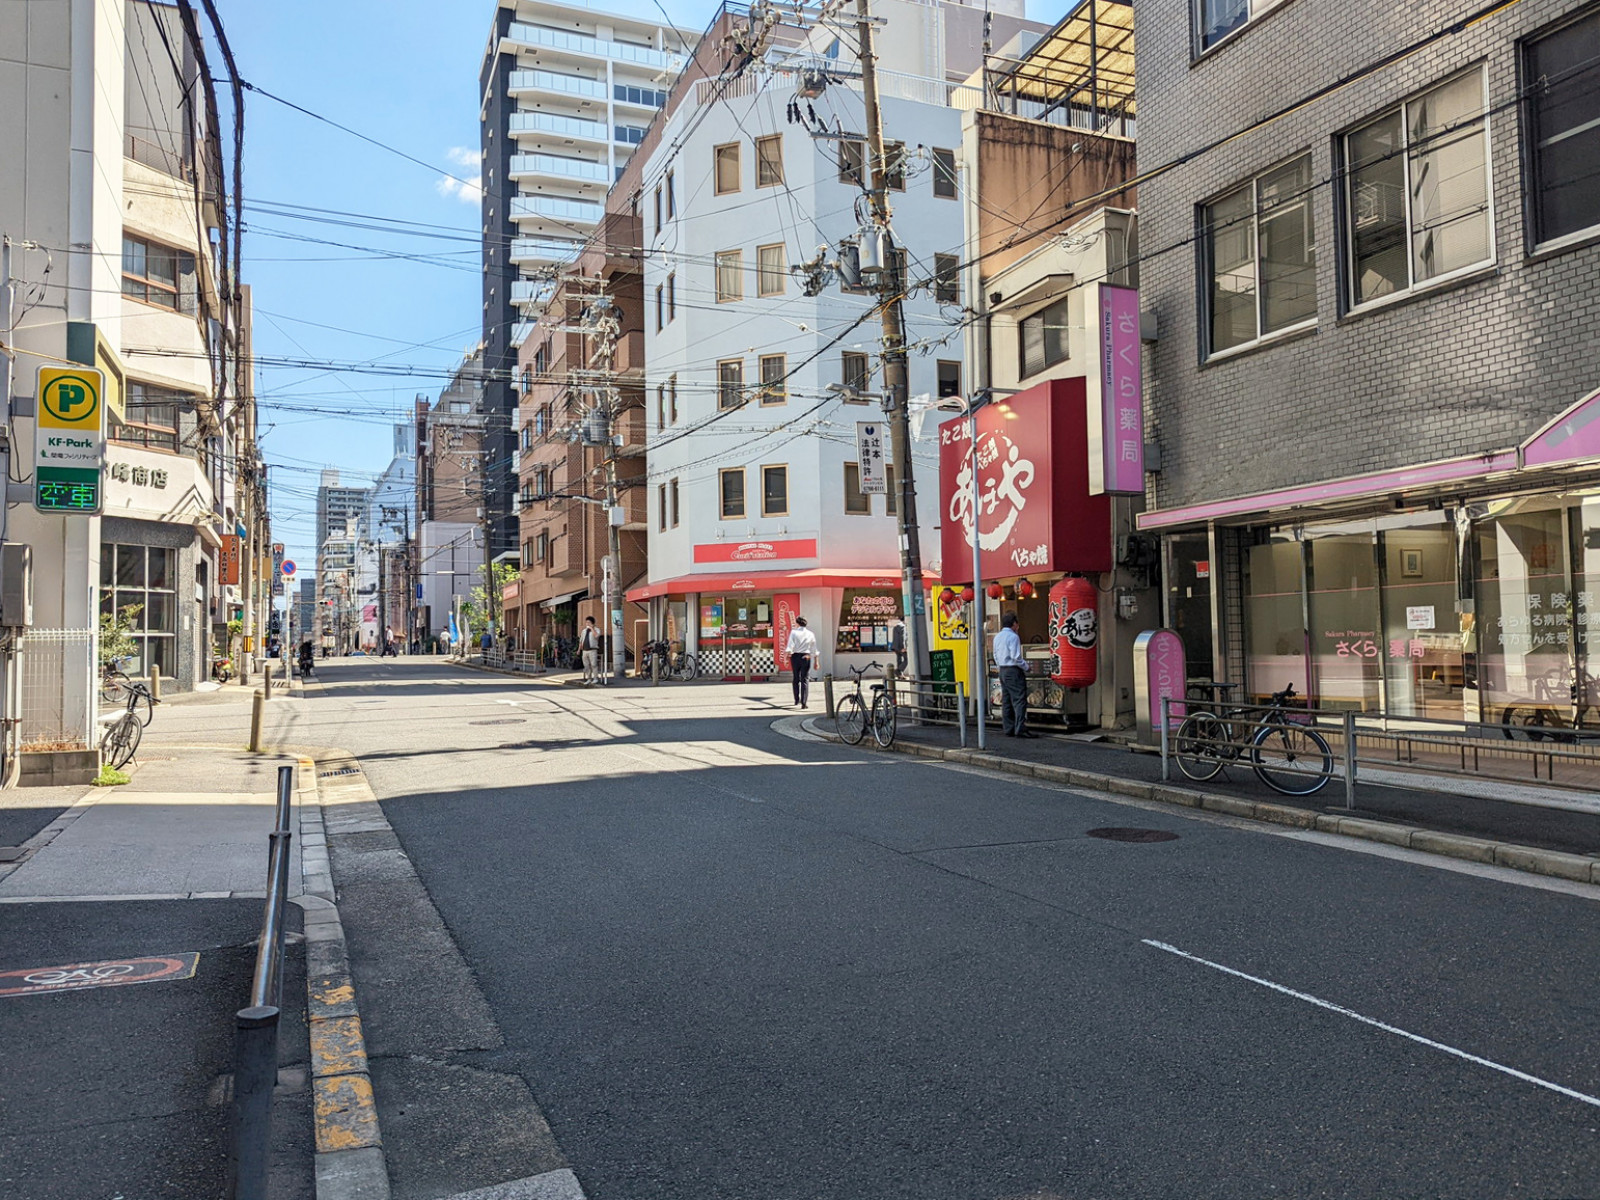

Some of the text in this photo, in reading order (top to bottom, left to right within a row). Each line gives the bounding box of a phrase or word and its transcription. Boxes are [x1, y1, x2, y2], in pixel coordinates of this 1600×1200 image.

[1118, 311, 1138, 463] さくら薬局
[48, 437, 93, 448] KF-Park
[942, 420, 972, 445] たこ焼
[861, 438, 872, 476] 法律特許
[871, 437, 881, 459] 辻本
[40, 482, 95, 509] 空車
[1336, 640, 1424, 658] さくら薬局
